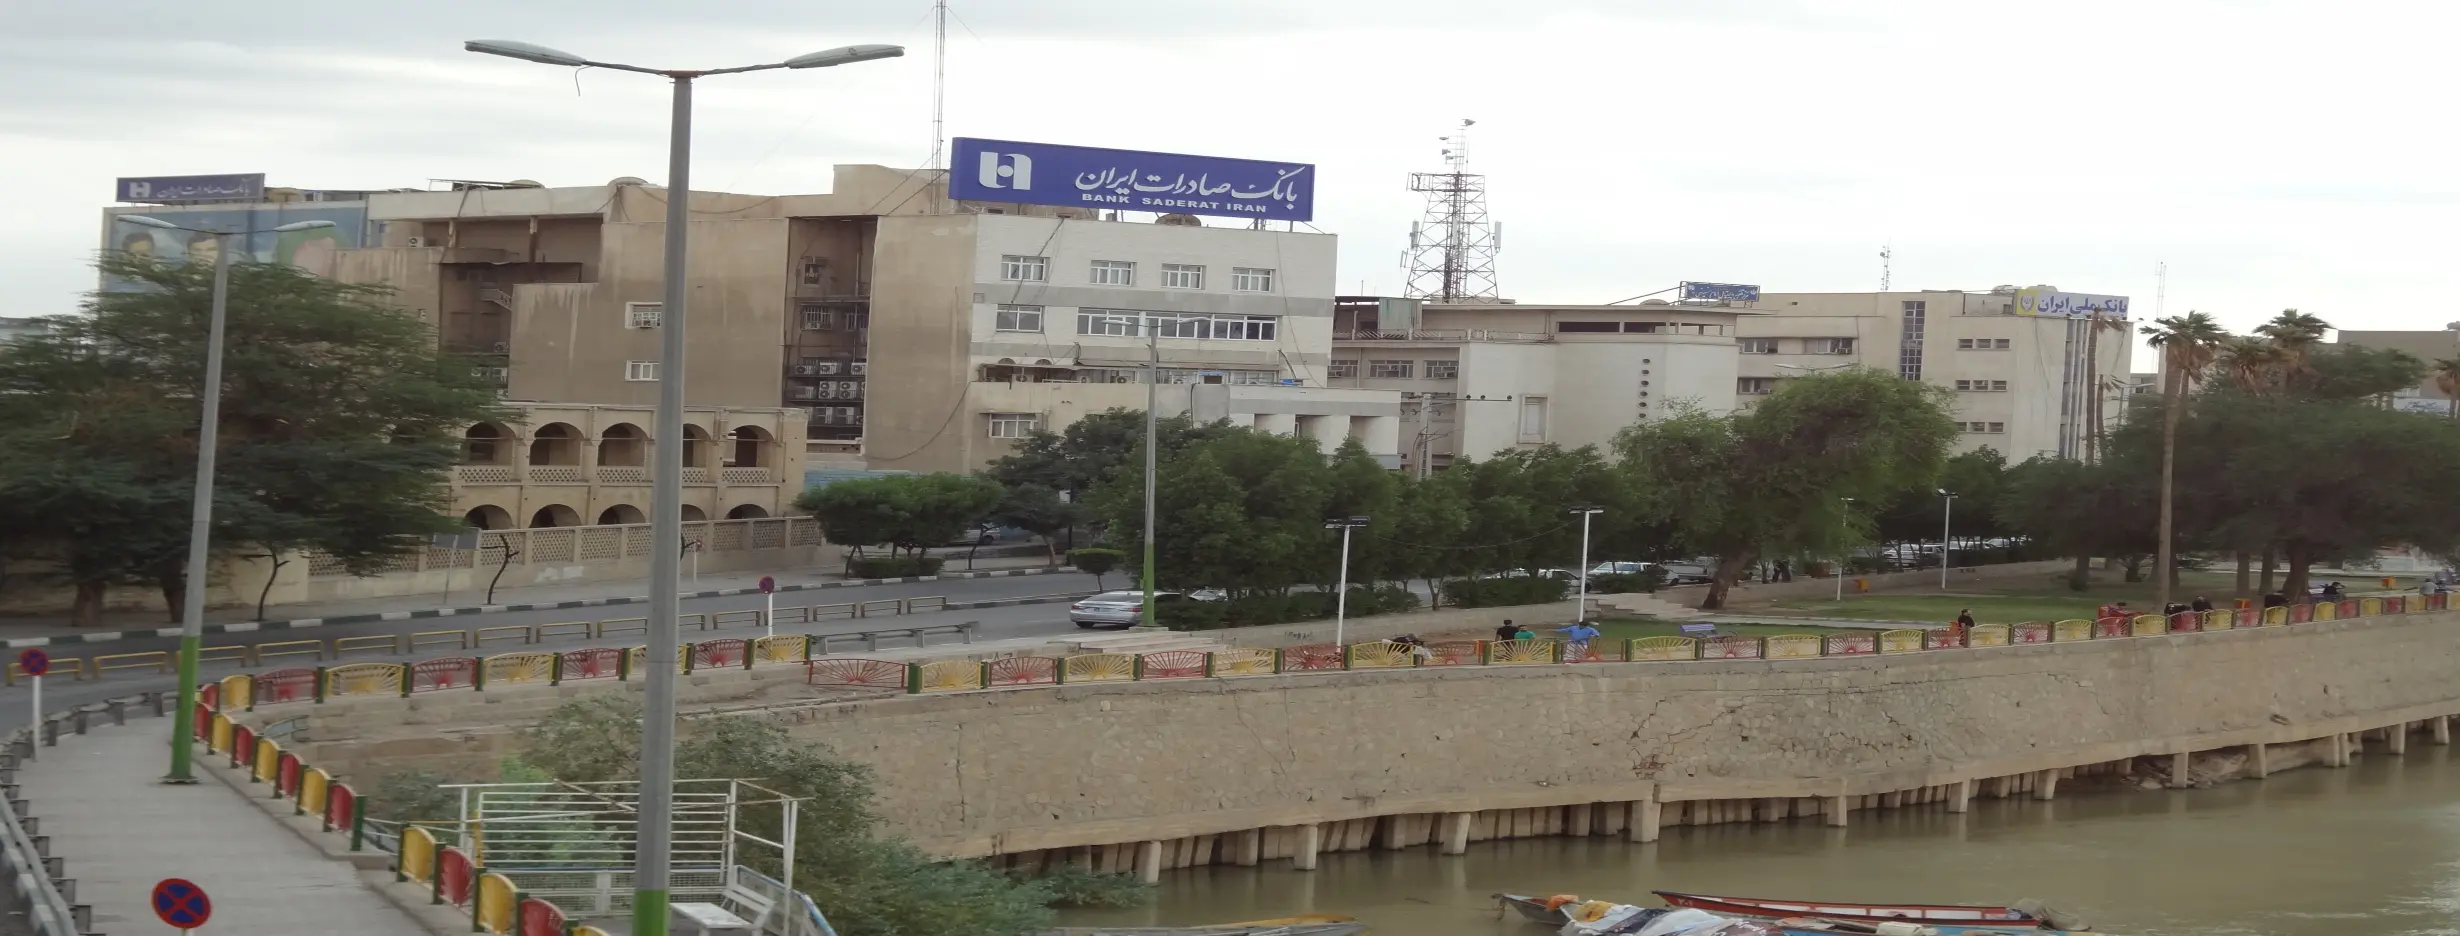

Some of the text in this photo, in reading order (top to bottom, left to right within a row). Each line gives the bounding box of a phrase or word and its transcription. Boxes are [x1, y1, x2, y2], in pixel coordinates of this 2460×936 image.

[1075, 166, 1306, 210] بانک صادرات ایران
[1082, 193, 1266, 213] BANK SADERAT IRAN
[2038, 296, 2127, 317] بانک ملی ایران
